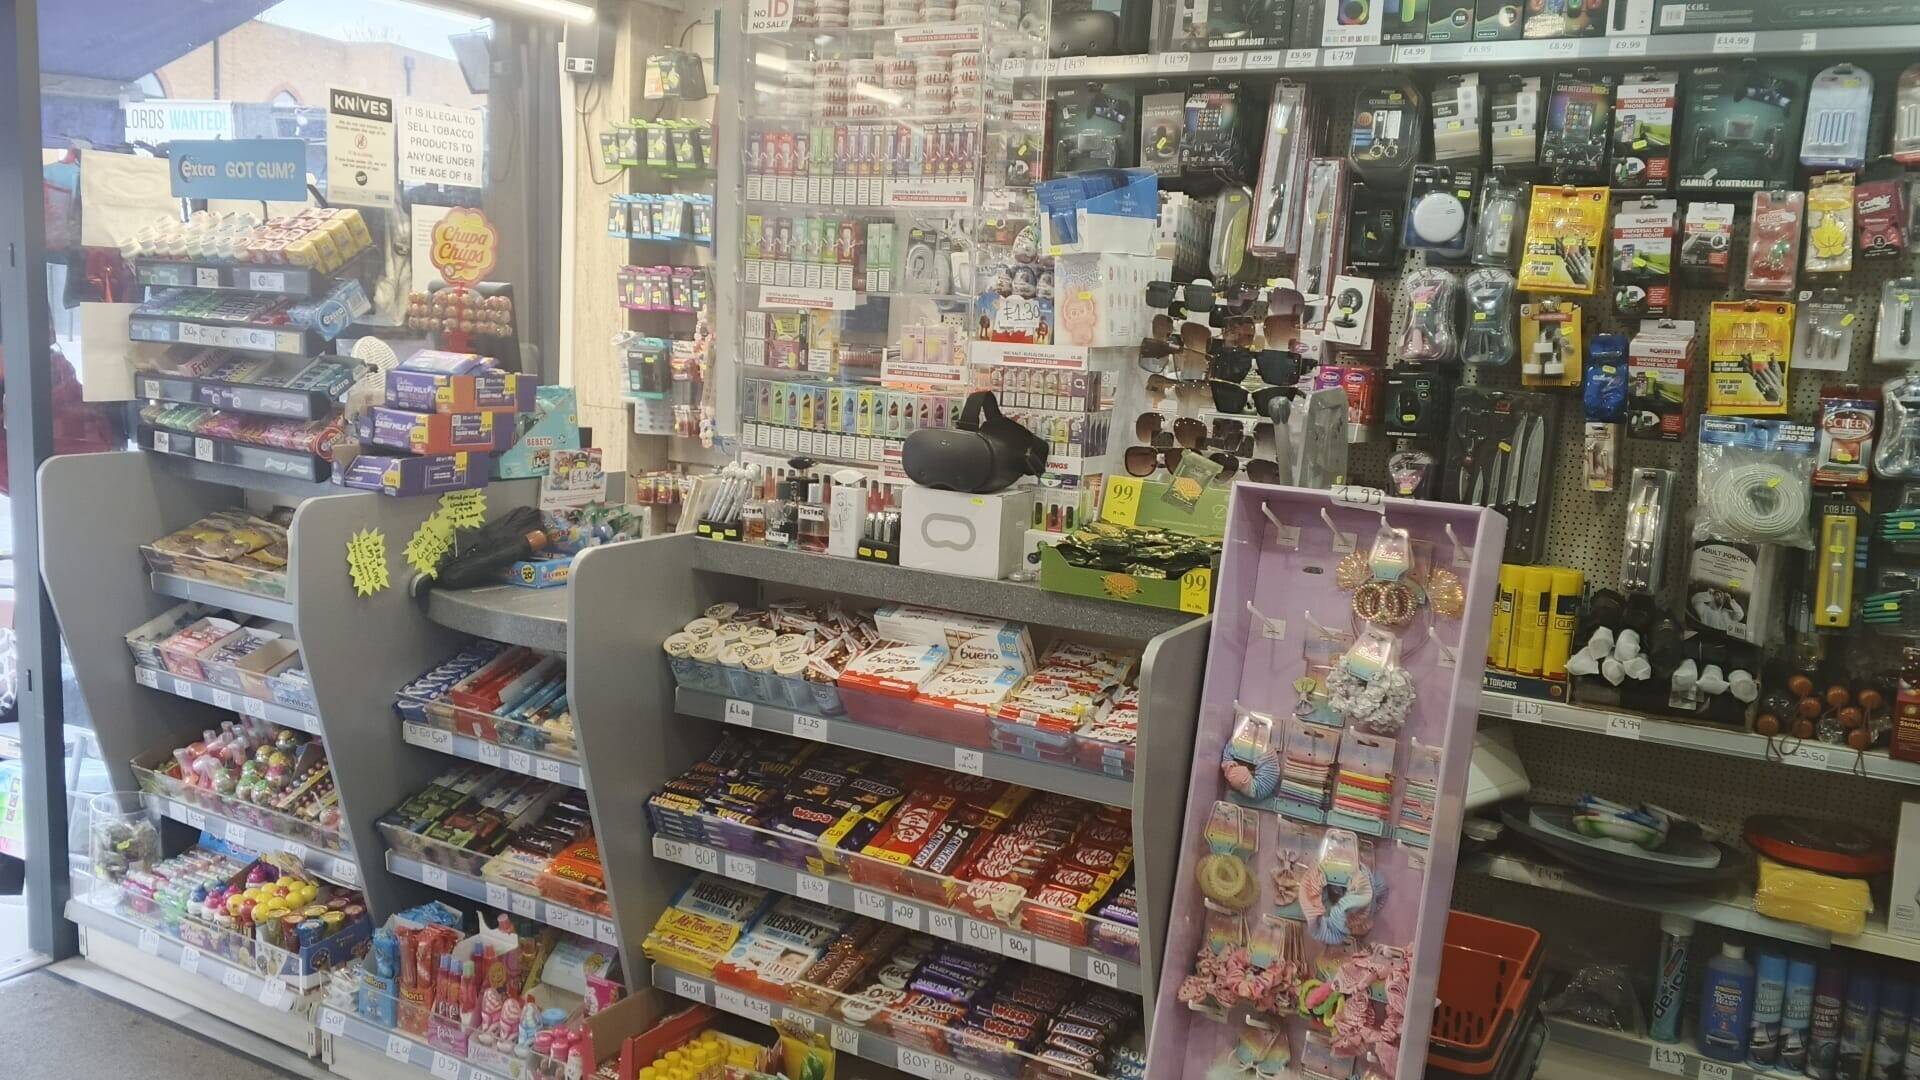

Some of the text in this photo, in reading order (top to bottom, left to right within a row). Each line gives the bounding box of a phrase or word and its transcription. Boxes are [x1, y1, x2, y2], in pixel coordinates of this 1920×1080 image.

[768, 0, 789, 17] ID
[752, 21, 765, 29] NO
[1208, 37, 1265, 47] GAMING HEADSET
[1616, 41, 1641, 49] £9.99
[1717, 36, 1750, 46] £14.99
[1290, 51, 1312, 60] £9.99
[1403, 47, 1426, 56] £4.99
[1216, 55, 1238, 63] £9.99
[1251, 54, 1273, 63] £9.99
[334, 94, 388, 116] KNIVES
[169, 110, 228, 130] WANTED!
[415, 108, 424, 117] IS
[425, 110, 463, 124] ILLEGAL
[465, 116, 475, 125] TO
[407, 123, 474, 139] SELL TOBACCO
[410, 137, 472, 153] PRODUCTS TO
[407, 151, 475, 167] ANYONE UNDER
[181, 157, 296, 179] extra GOT GUM?
[410, 166, 472, 181] THE AGE OF 18
[1681, 179, 1764, 188] GAMING CONTROLLER
[442, 226, 487, 247] Chupa
[439, 242, 485, 264] Chups
[1004, 300, 1040, 321] £1.30
[1827, 418, 1871, 431] SCREEN
[526, 438, 552, 447] BEBETO
[1336, 487, 1382, 505] 1.99
[1701, 547, 1750, 564] ADULT PONCHO
[866, 655, 916, 666] bueno
[960, 649, 999, 661] bueno
[943, 675, 989, 686] bueno
[1489, 680, 1517, 690] TORCHES
[797, 717, 820, 729] £1.25
[1107, 904, 1130, 915] DAIRY
[763, 912, 823, 939] HERSHEY'S
[1101, 922, 1126, 933] DAIRY
[918, 994, 959, 1014] Daim
[1055, 1022, 1097, 1039] SNICKERS
[1703, 1064, 1727, 1076] £2.00
